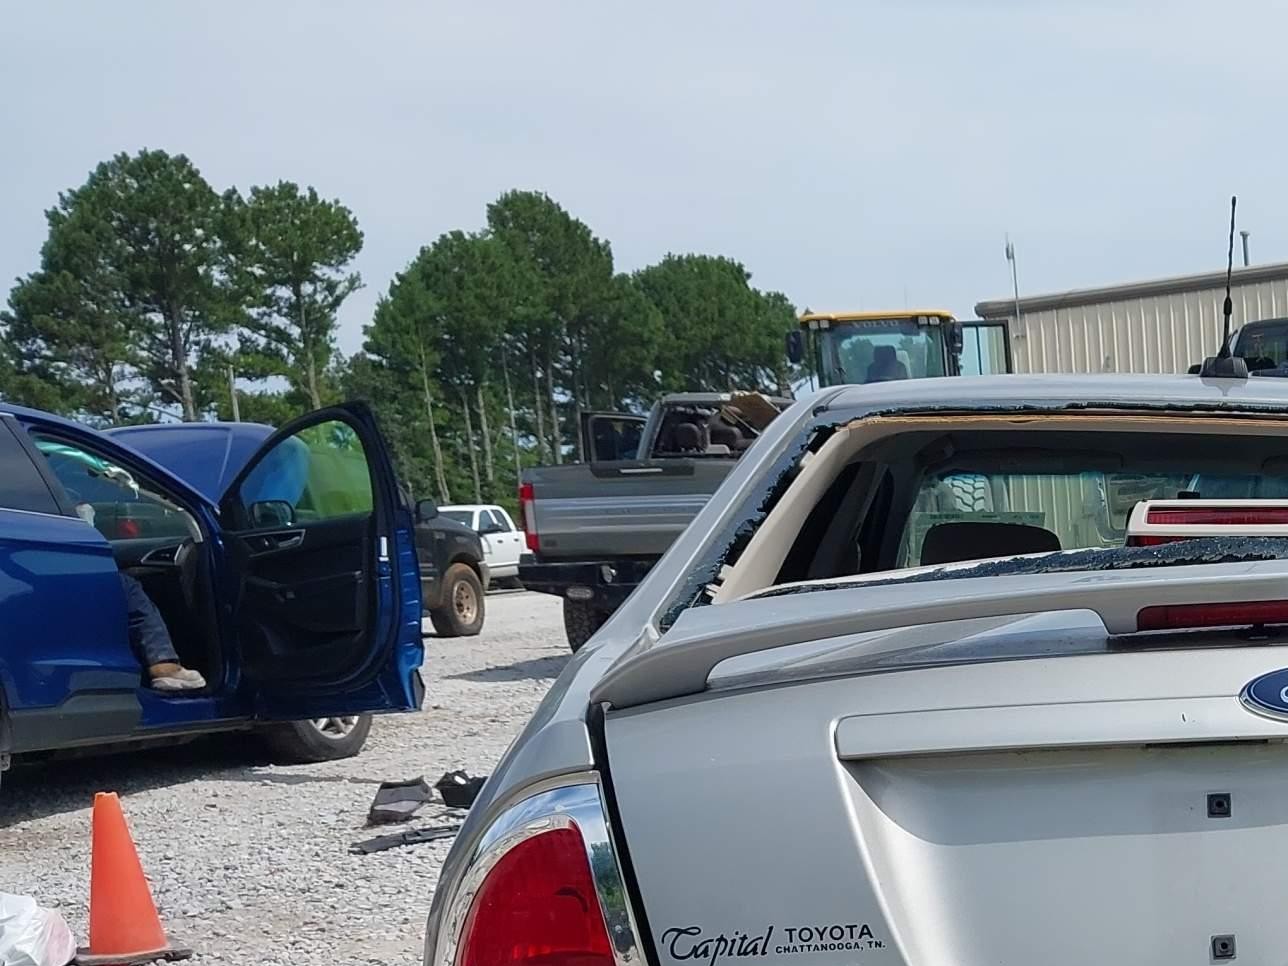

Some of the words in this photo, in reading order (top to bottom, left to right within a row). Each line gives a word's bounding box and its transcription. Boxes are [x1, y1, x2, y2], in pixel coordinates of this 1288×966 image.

[784, 924, 874, 943] TOYOTA
[775, 943, 864, 955] CHATTANOOGA,
[867, 940, 886, 949] TN.
